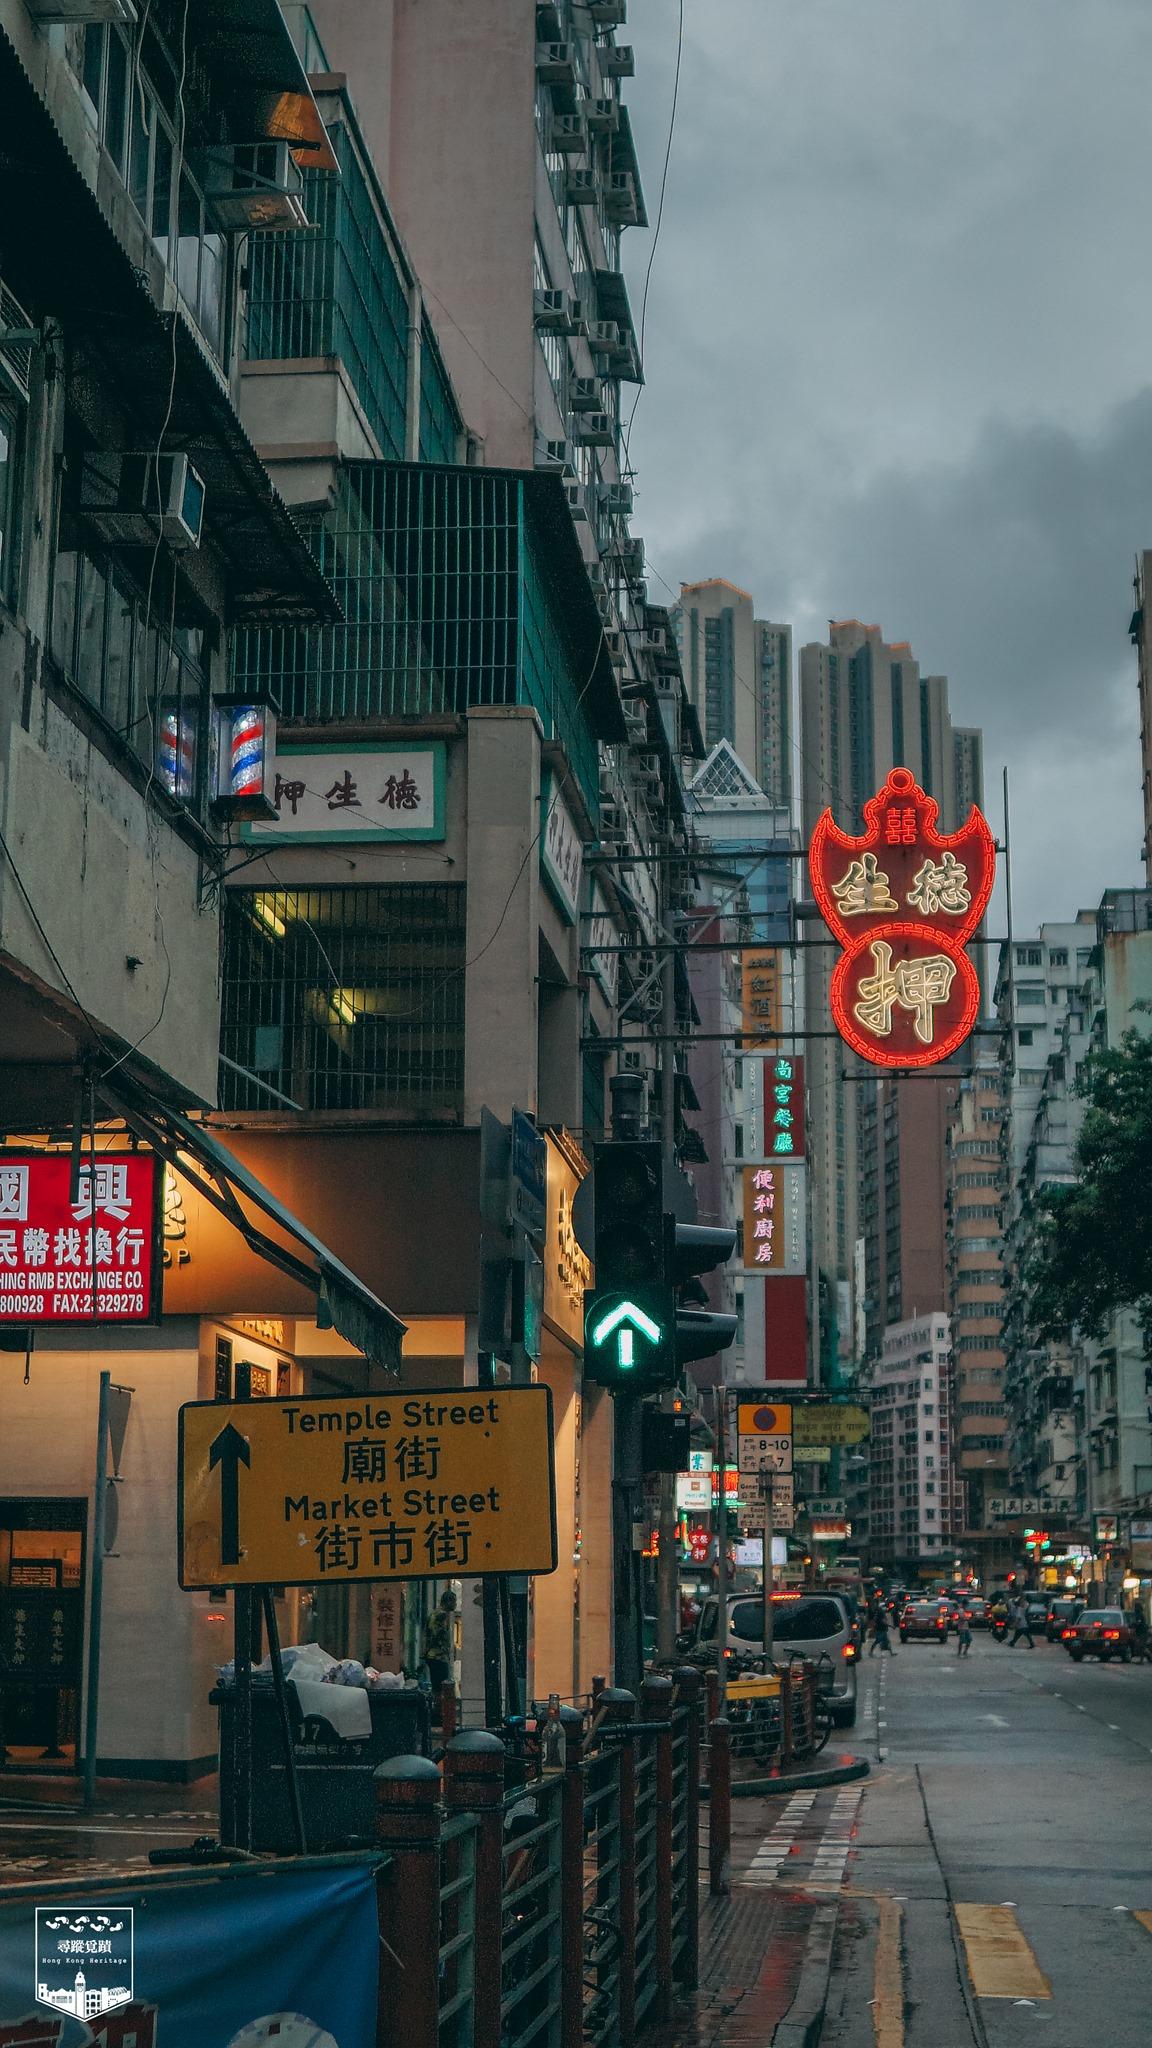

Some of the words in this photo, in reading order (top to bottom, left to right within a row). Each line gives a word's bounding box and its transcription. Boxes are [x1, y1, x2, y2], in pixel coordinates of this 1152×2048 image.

[854, 940, 957, 1043] 押
[28, 1272, 54, 1289] RMB
[125, 1271, 144, 1288] CO.
[282, 1404, 391, 1435] Temple
[403, 1400, 499, 1427] Street
[341, 1437, 441, 1484] 廟街
[759, 1440, 789, 1450] 8-10
[284, 1492, 392, 1521] Market
[403, 1487, 500, 1515] Street
[314, 1519, 472, 1572] 街市街
[377, 1599, 394, 1657] 裝修工程
